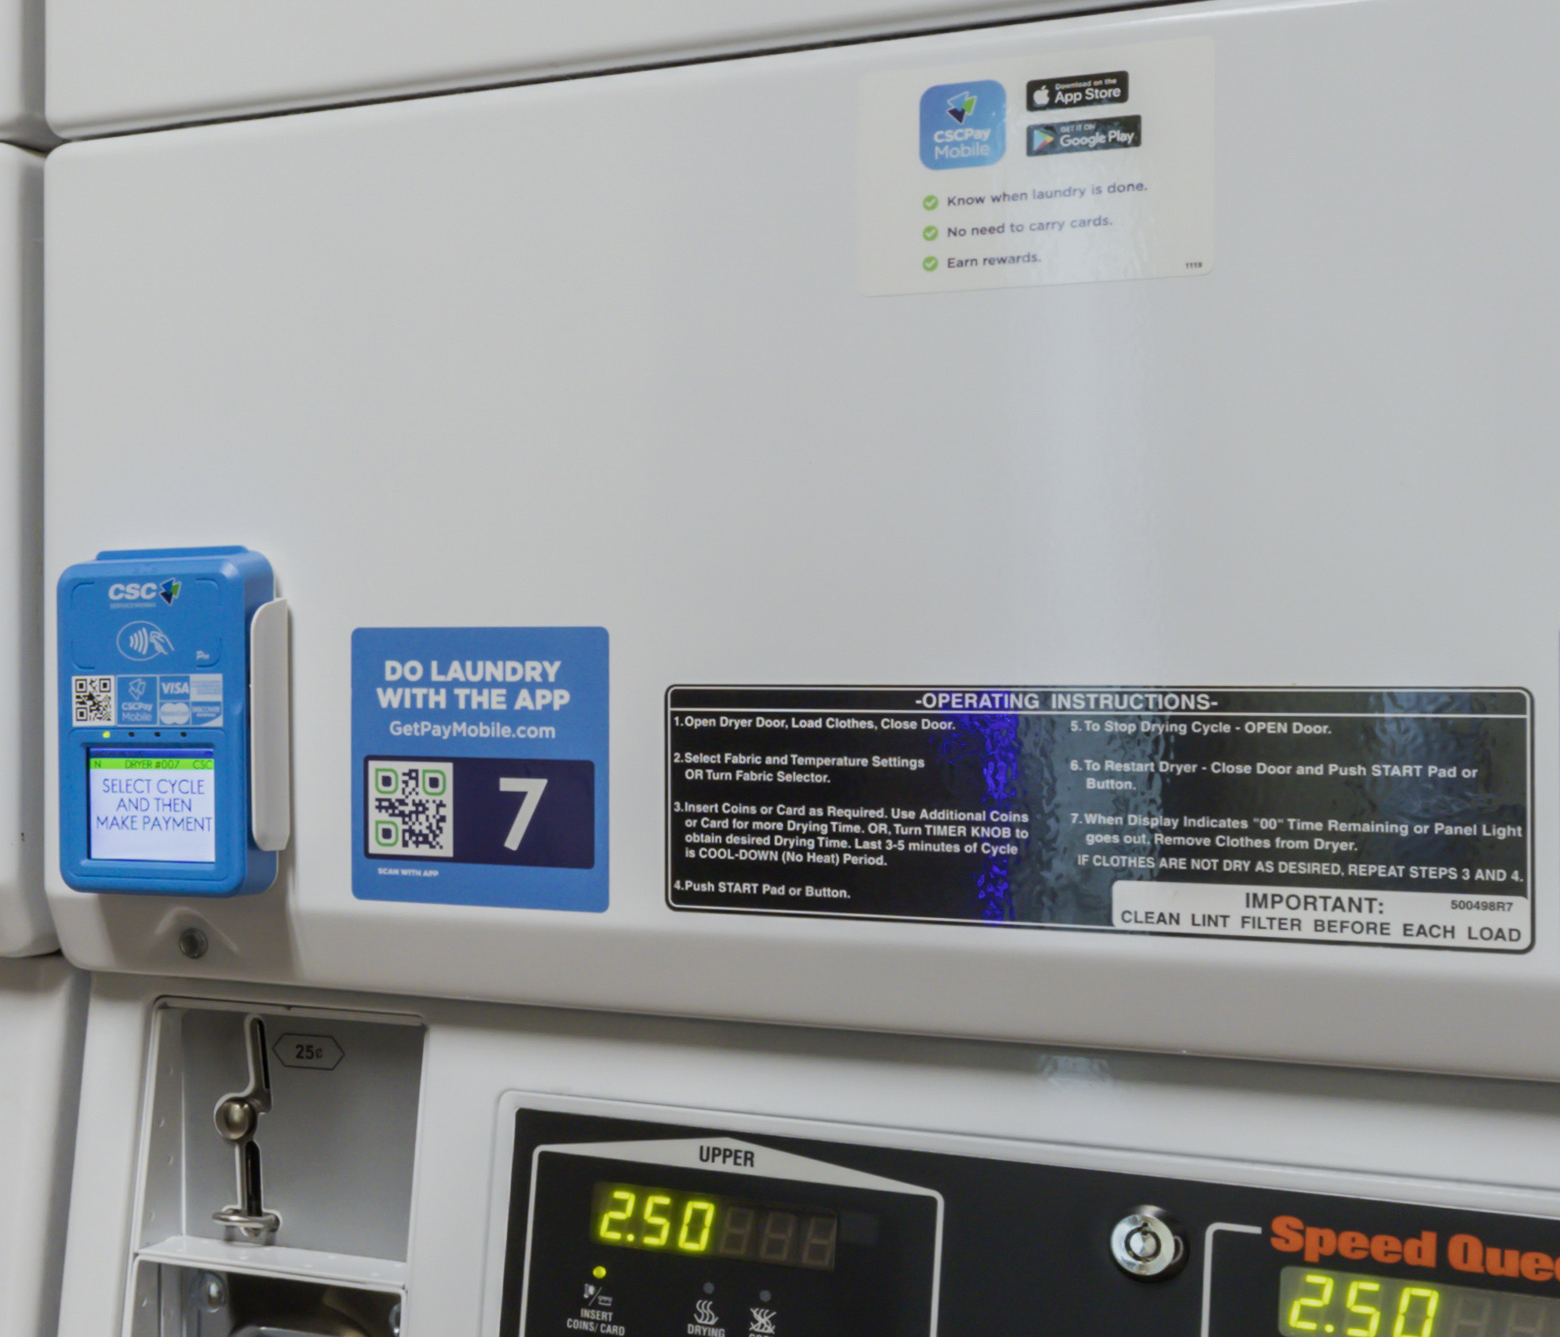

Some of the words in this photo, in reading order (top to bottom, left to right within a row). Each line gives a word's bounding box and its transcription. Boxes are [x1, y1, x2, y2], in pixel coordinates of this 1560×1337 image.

[1055, 81, 1092, 91] Download
[1104, 78, 1117, 86] the
[1054, 90, 1082, 104] App
[1086, 86, 1122, 101] Store
[934, 127, 991, 143] CSCPay
[1060, 133, 1106, 149] Google
[1108, 130, 1134, 144] Play
[935, 142, 990, 160] Mobile
[947, 194, 985, 207] Know
[991, 190, 1028, 203] when
[1032, 185, 1086, 200] laundry
[1091, 184, 1102, 196] is
[1107, 181, 1148, 194] done.
[947, 227, 967, 237] No
[971, 223, 1005, 236] need
[1010, 222, 1024, 233] to
[1029, 219, 1065, 233] carry
[1070, 216, 1113, 228] cards.
[947, 256, 978, 269] Earn
[983, 252, 1042, 266] rewards.
[108, 583, 157, 600] CSC
[384, 660, 424, 682] DO
[431, 660, 562, 682] LAUNDRY
[161, 682, 189, 695] VISA
[376, 688, 447, 709] WITH
[453, 688, 507, 710] THE
[514, 689, 571, 711] APP
[915, 693, 1040, 709] -OPERATING
[389, 721, 556, 740] GetPayMobile.com
[720, 716, 753, 730] Dryer
[756, 717, 789, 730] Door,
[791, 717, 822, 729] Load
[825, 718, 878, 731] Clothes,
[880, 718, 918, 730] Close
[921, 719, 956, 730] Door.
[94, 760, 102, 769] N
[125, 760, 153, 770] DRYER
[155, 760, 180, 770] #007
[192, 760, 213, 770] CSC
[724, 753, 762, 765] Fabric
[765, 754, 787, 765] and
[791, 755, 868, 768] Temperature
[871, 755, 925, 769] Settings
[499, 777, 548, 852] 7
[377, 868, 399, 876] SCAN
[401, 868, 422, 876] WITH
[423, 869, 439, 877] APP
[1244, 892, 1385, 915] IMPORTANT:
[1450, 899, 1513, 912] 500498R7
[1121, 910, 1181, 926] CLEAN
[1191, 913, 1231, 929] LINT
[1240, 915, 1302, 932] FILTER
[1313, 918, 1391, 936] BEFORE
[1402, 923, 1456, 940] EACH
[1467, 925, 1522, 943] LOAD
[295, 1043, 324, 1061] 25¢
[699, 1145, 756, 1168] UPPER
[599, 1190, 716, 1251] 2.50
[1270, 1214, 1438, 1268] Speed
[580, 1308, 614, 1323] INSERT
